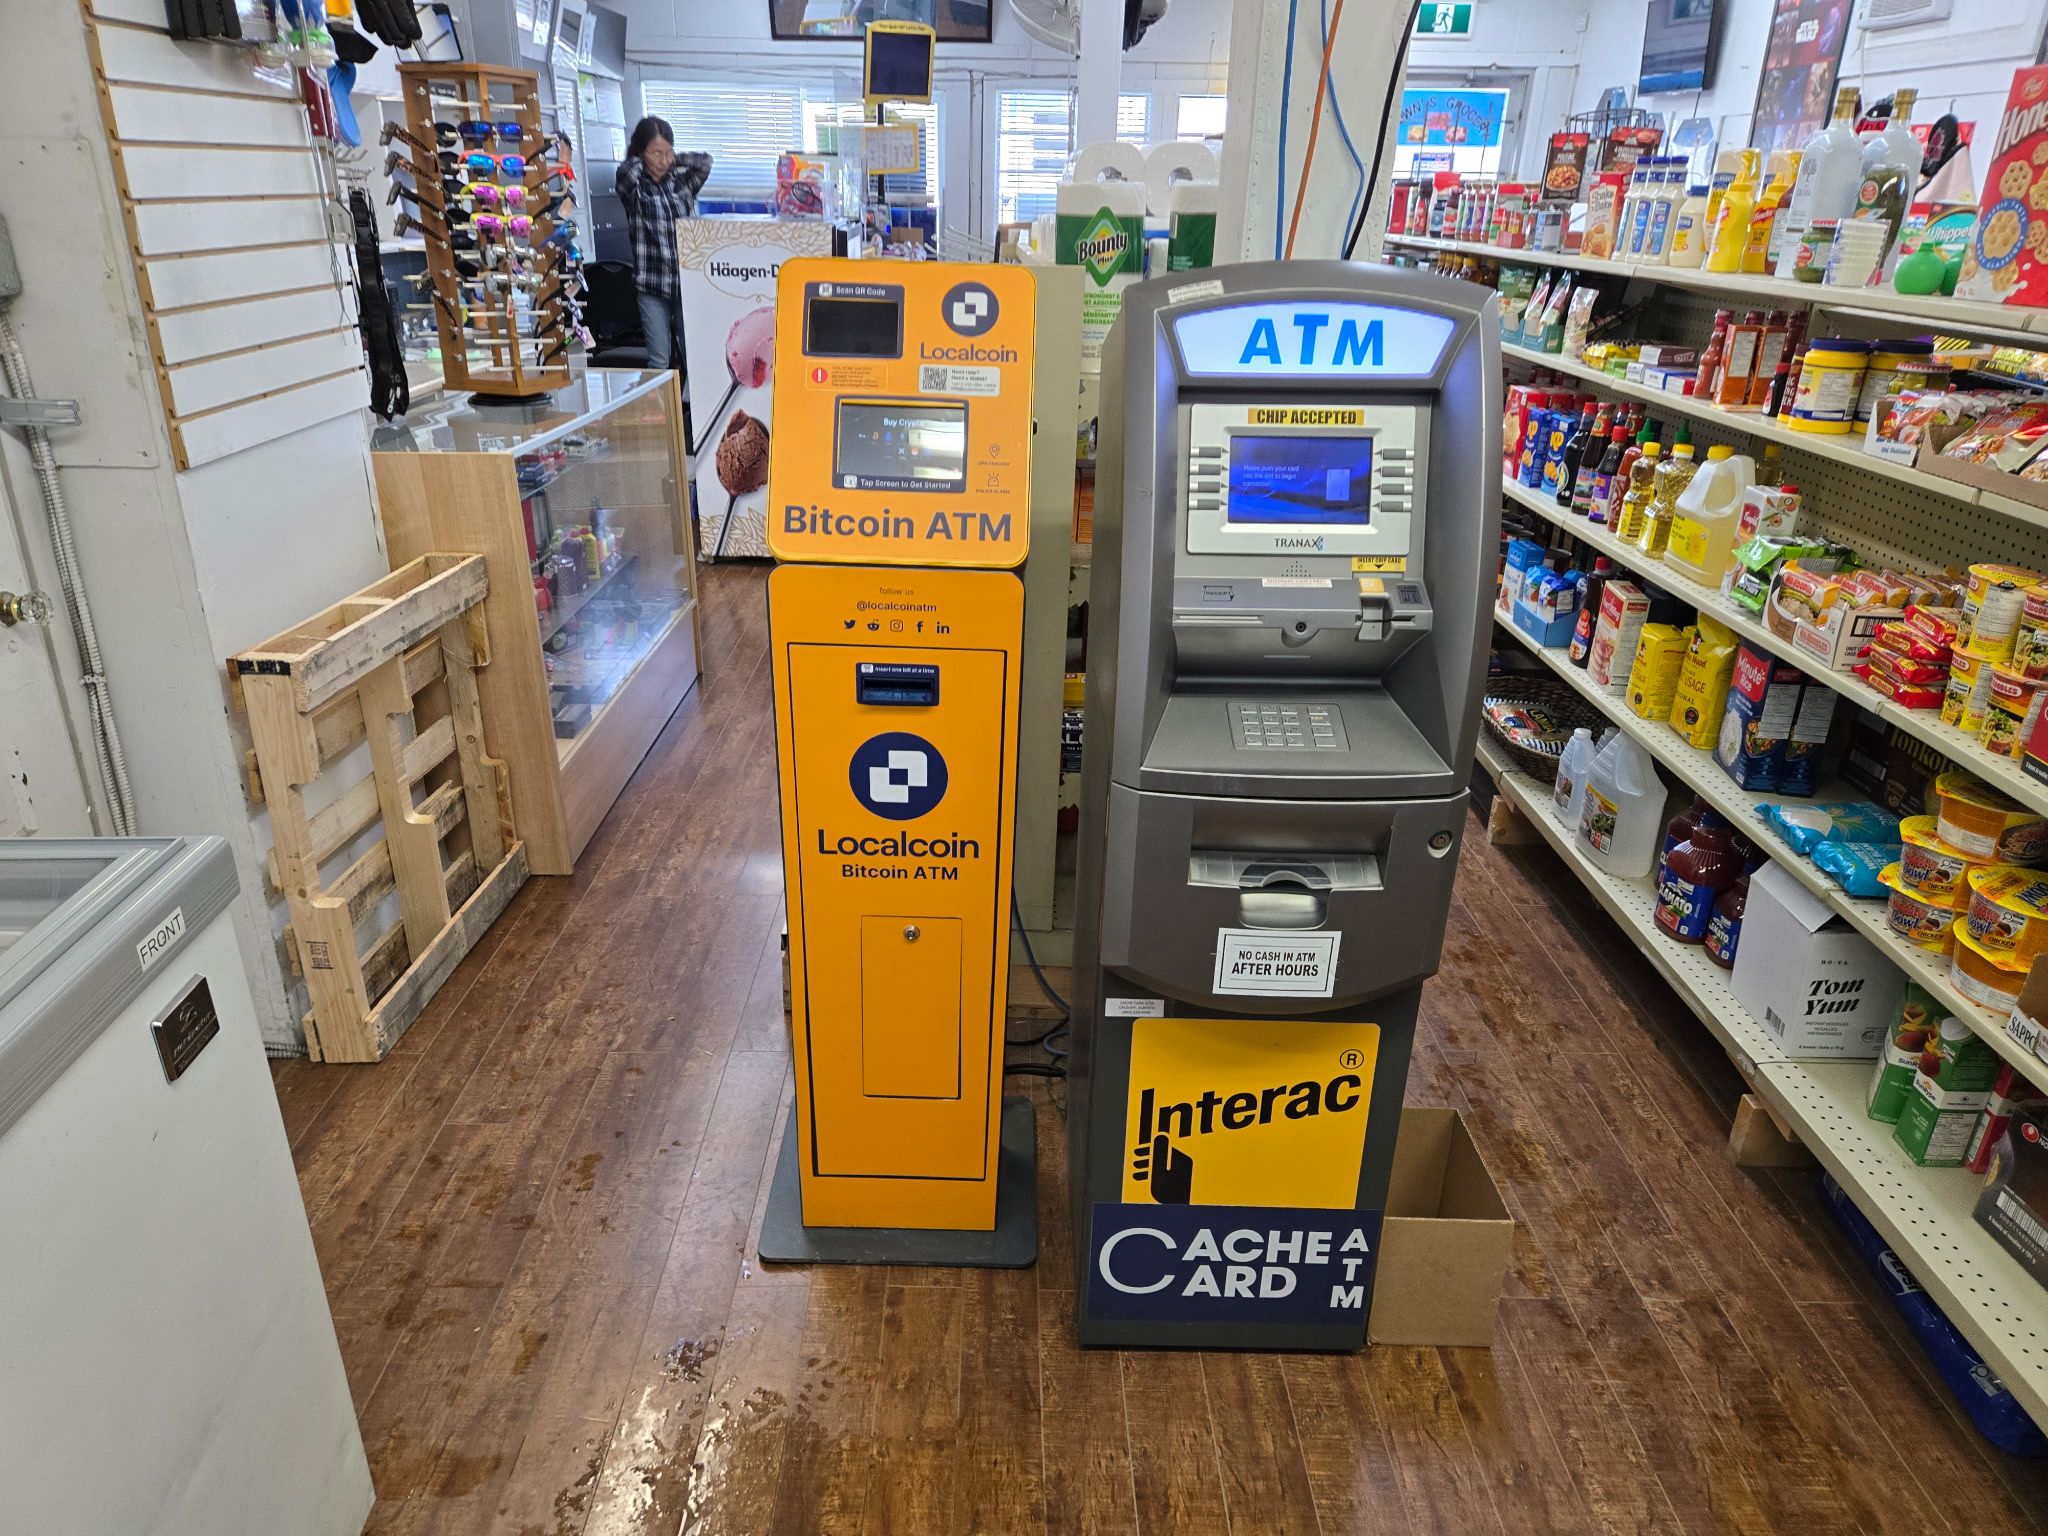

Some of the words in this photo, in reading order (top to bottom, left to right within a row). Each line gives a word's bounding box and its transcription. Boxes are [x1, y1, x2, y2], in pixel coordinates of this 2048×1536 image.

[1079, 231, 1128, 263] Bounty
[836, 287, 853, 295] Scan
[855, 287, 866, 295] QR
[868, 287, 886, 296] Code
[1239, 313, 1383, 366] ATM
[920, 342, 1018, 363] Localcoin
[884, 418, 898, 427] Buy
[1257, 409, 1288, 424] CHIP
[1290, 410, 1357, 425] ACCEPTED
[861, 480, 874, 488] Tap
[875, 480, 900, 488] Screen
[901, 480, 908, 488] to
[910, 480, 923, 489] Get
[924, 481, 951, 489] Started
[784, 505, 915, 539] Bitcoin
[926, 511, 1011, 542] ATM
[1274, 538, 1320, 548] TRANAX
[879, 586, 903, 595] follow
[856, 600, 937, 613] @localcoinatm
[1738, 656, 1761, 685] Minute
[1685, 678, 1706, 694] USAGE
[1740, 675, 1753, 692] Rice
[818, 829, 980, 859] Localcoin
[842, 864, 908, 879] Bitcoin
[913, 866, 958, 880] ATM
[1927, 882, 1954, 893] CHICKEN
[139, 914, 182, 964] FRONT
[1916, 930, 1944, 939] CHICKEN
[1988, 936, 2016, 948] CHICKEN
[1238, 950, 1253, 961] NO
[1254, 950, 1281, 962] CASH
[1283, 951, 1293, 962] IN
[1295, 951, 1316, 963] ATM
[1231, 962, 1272, 976] AFTER
[1275, 963, 1319, 977] HOURS
[1809, 979, 1865, 996] Tom
[1803, 998, 1860, 1016] Yum
[1137, 1073, 1361, 1145] Interac
